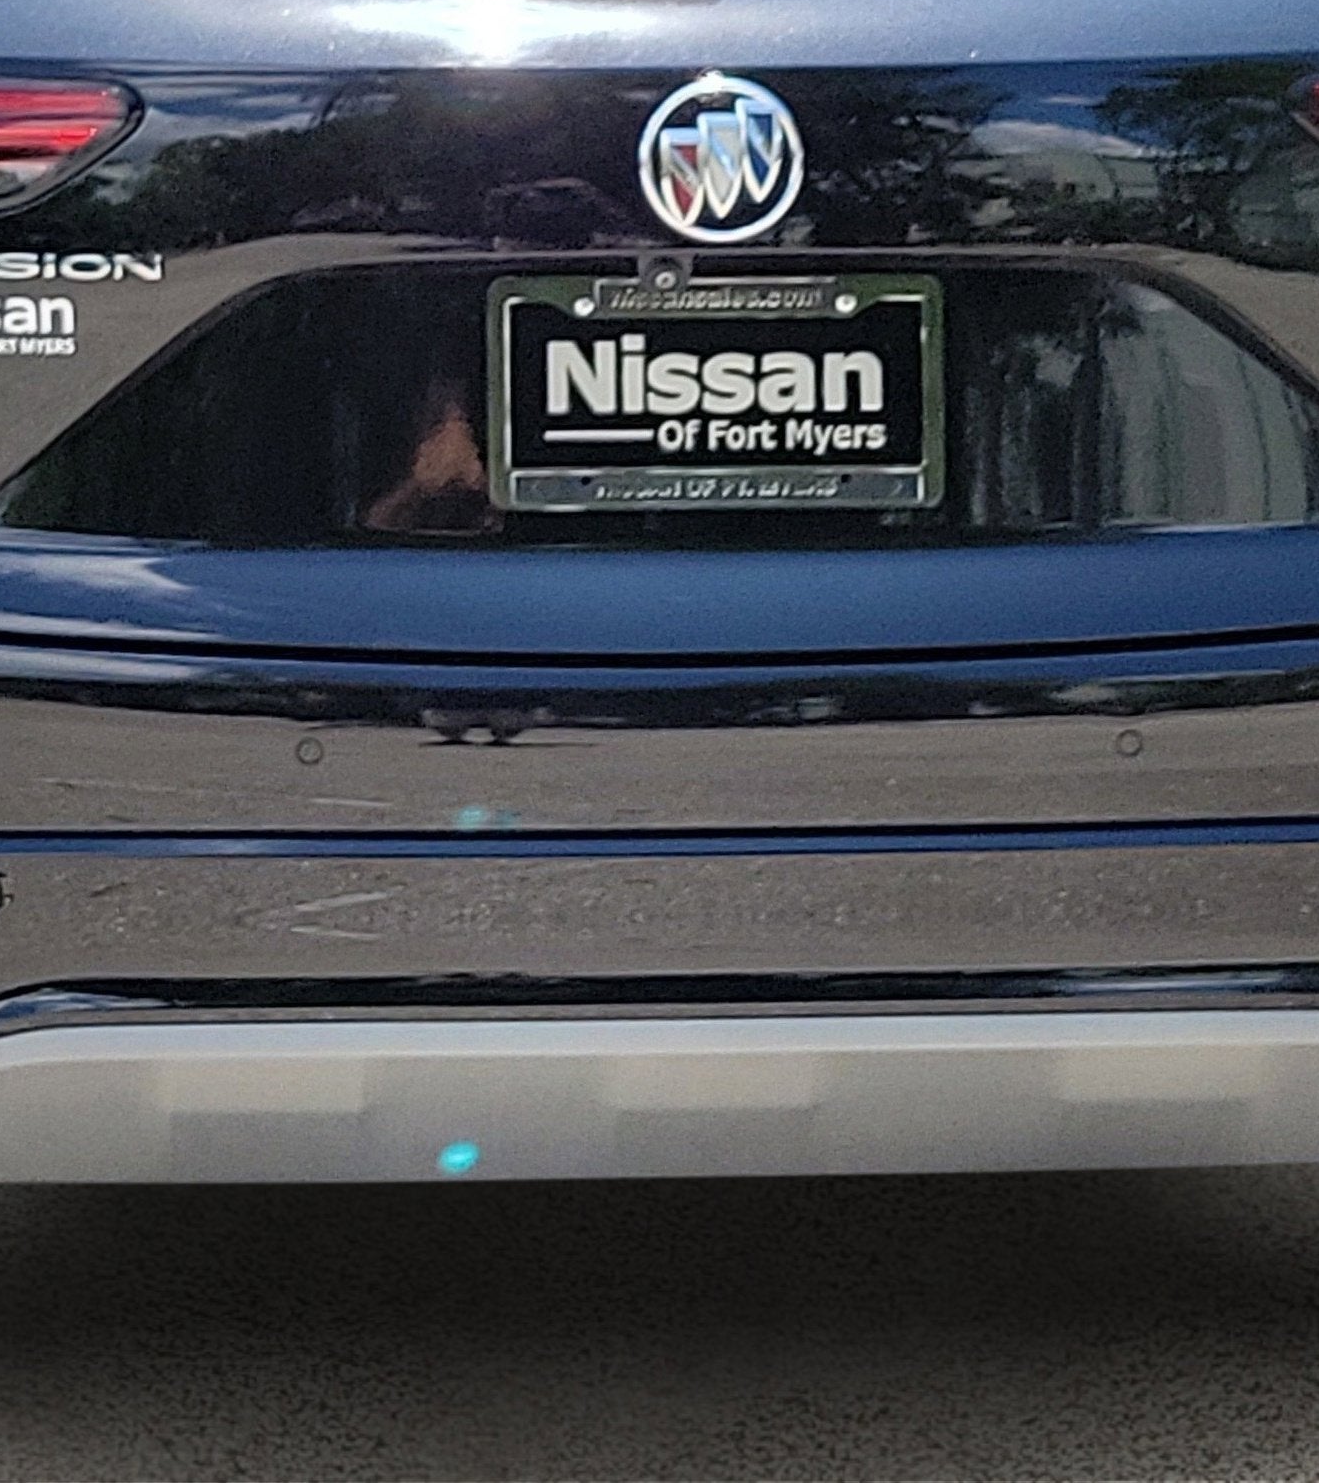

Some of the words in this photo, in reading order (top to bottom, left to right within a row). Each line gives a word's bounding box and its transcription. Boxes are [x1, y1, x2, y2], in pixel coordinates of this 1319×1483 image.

[547, 334, 884, 415] Nissan
[657, 419, 702, 452] Of
[707, 419, 778, 452] Fort
[785, 418, 888, 456] Myers
